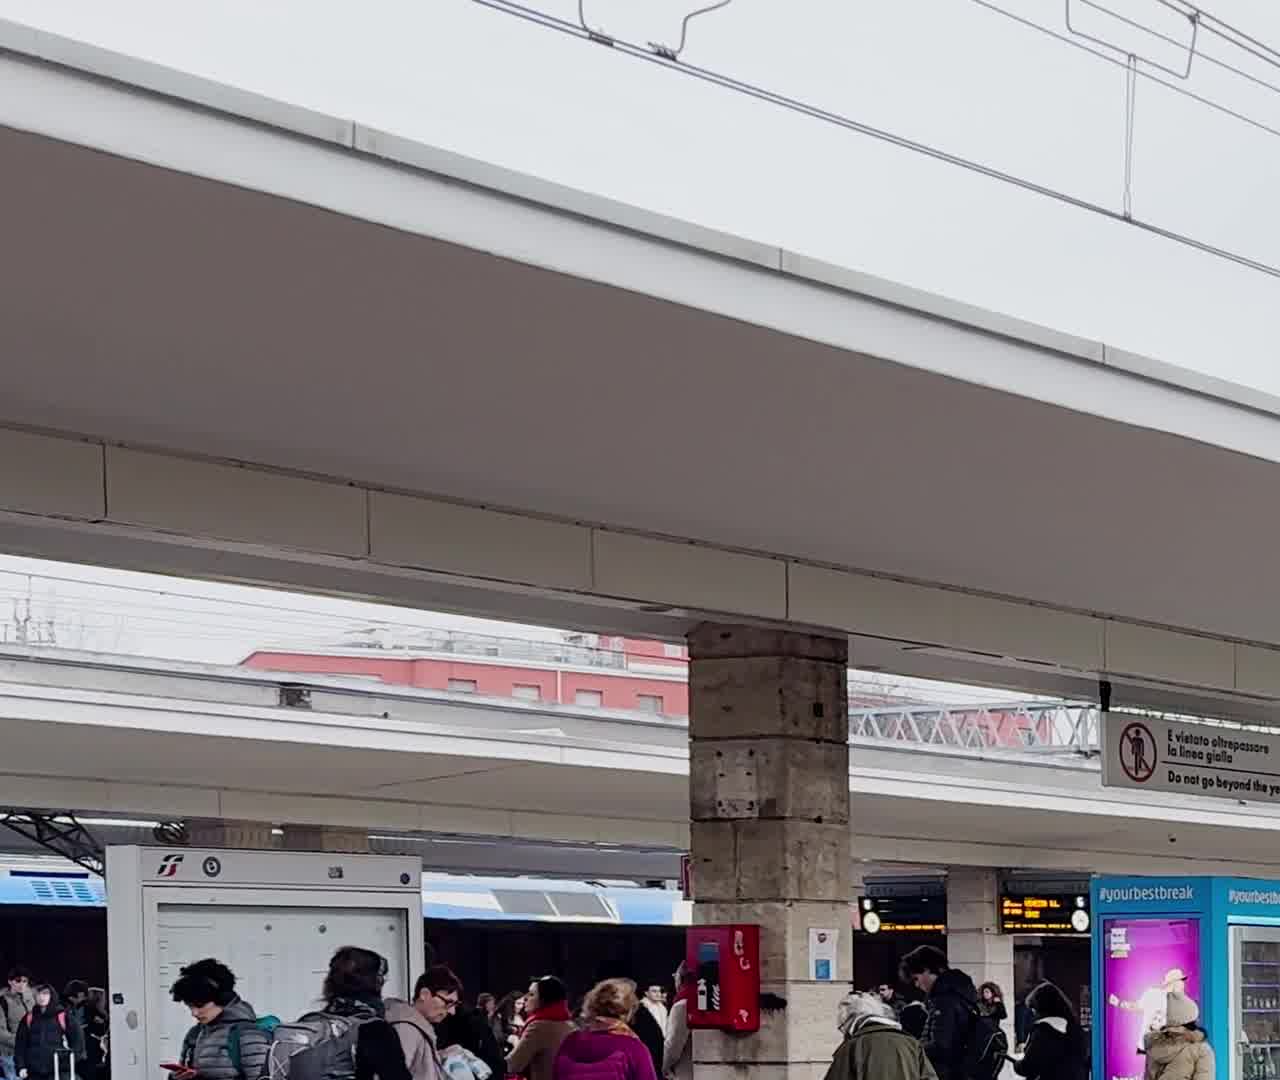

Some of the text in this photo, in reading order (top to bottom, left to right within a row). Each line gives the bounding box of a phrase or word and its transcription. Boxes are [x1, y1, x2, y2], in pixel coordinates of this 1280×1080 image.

[1175, 731, 1210, 747] vietato
[1211, 737, 1270, 755] oltrepassare
[1167, 745, 1233, 765] la linea gialla
[1167, 771, 1182, 784] Do
[1183, 773, 1200, 786] not
[1201, 777, 1215, 788] go
[1216, 776, 1251, 793] beyond
[1253, 780, 1268, 793] the
[1099, 885, 1194, 903] #yourbestbreak
